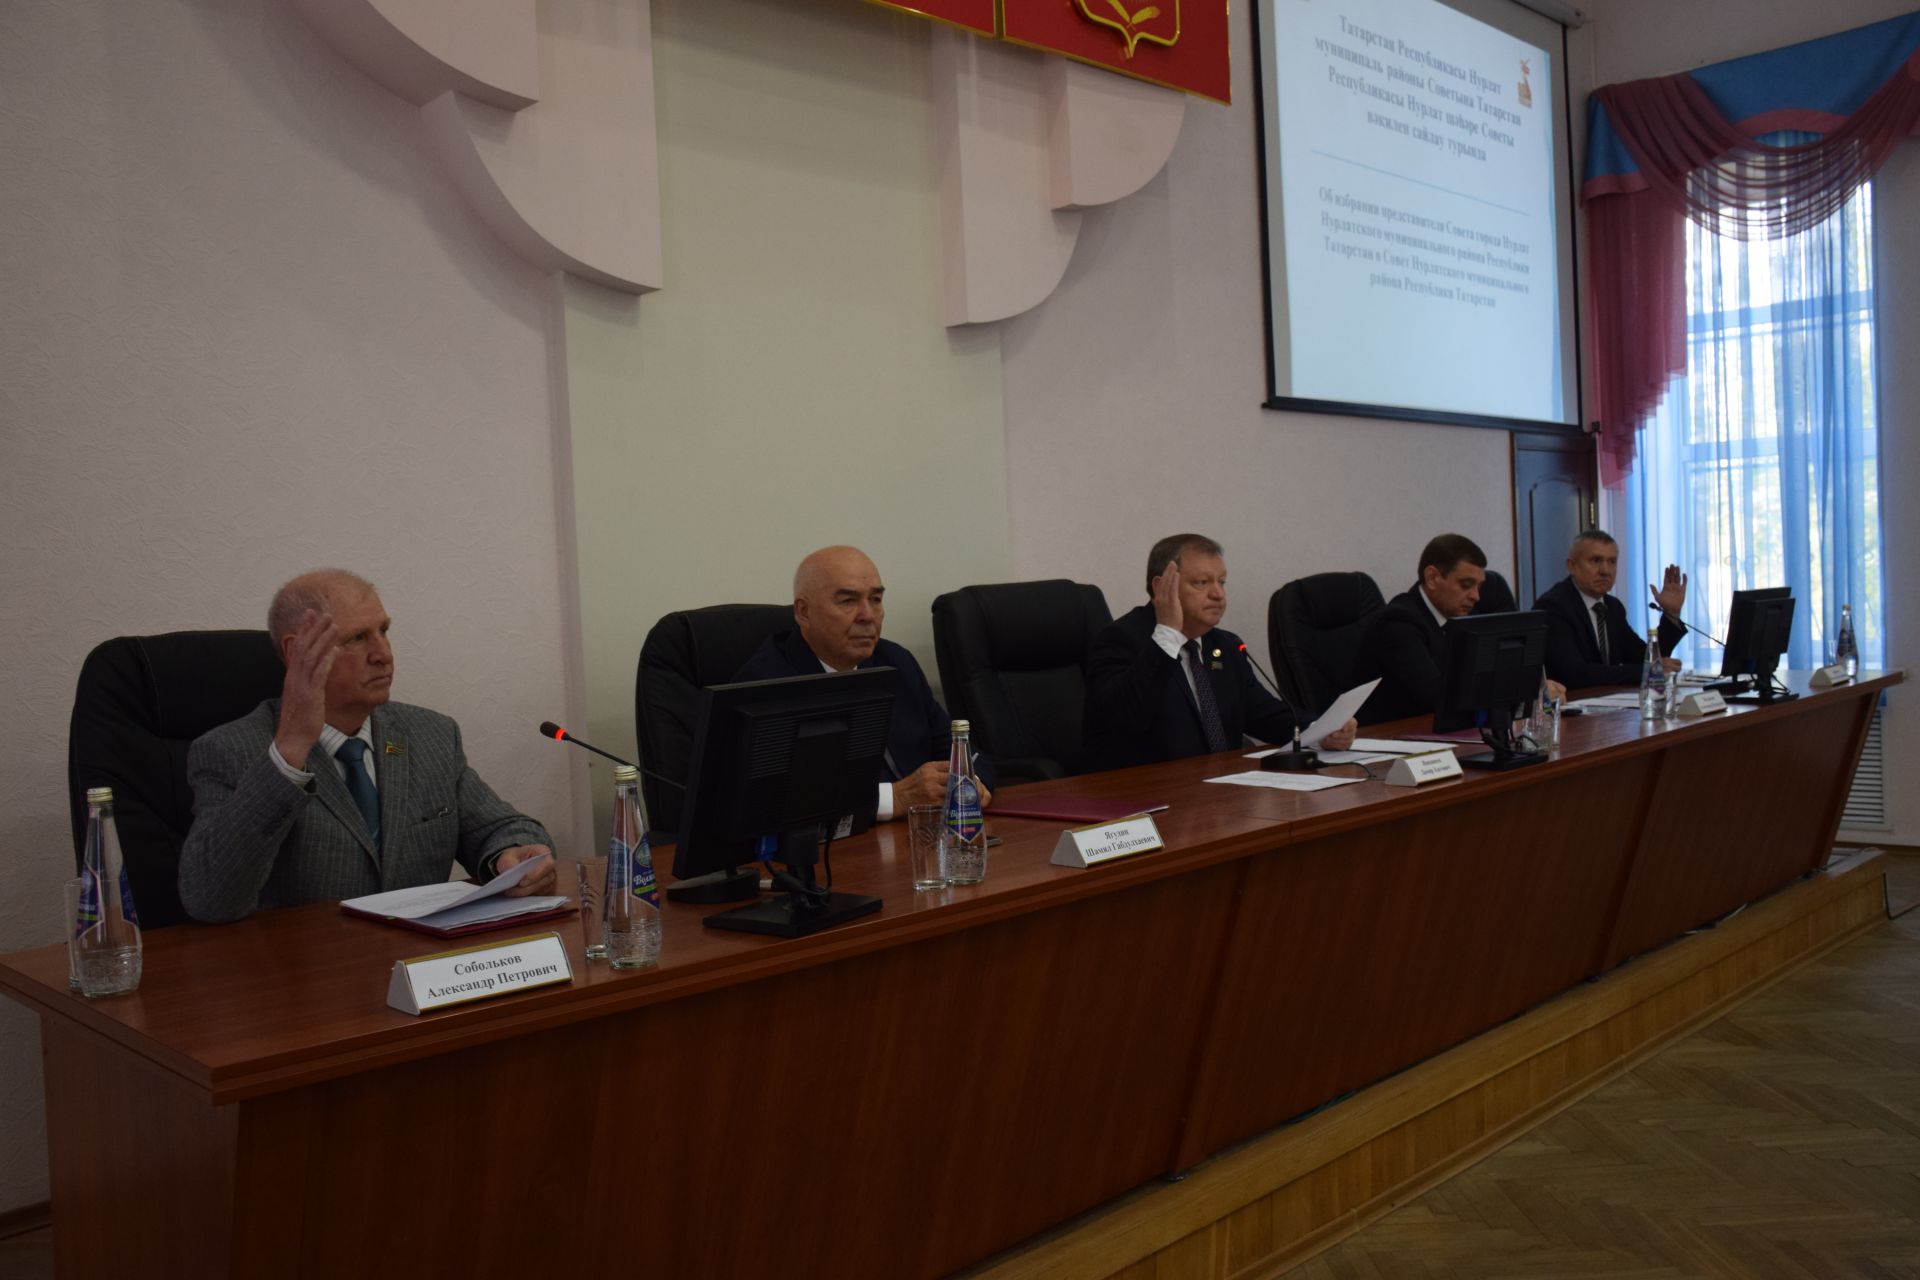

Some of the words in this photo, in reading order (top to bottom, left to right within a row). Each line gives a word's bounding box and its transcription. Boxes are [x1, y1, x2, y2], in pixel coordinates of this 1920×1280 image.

[1314, 37, 1384, 74] муниципаль
[1387, 64, 1424, 90] районы
[1427, 77, 1474, 108] Советына
[1476, 95, 1521, 127] Татарстан
[1338, 15, 1395, 51] Татарстан
[1398, 39, 1466, 80] Республикасы
[1469, 69, 1502, 95] Нурлат
[1328, 65, 1404, 107] Республикасы
[1407, 94, 1443, 121] Нурлат
[1481, 122, 1515, 147] Советы
[1412, 123, 1445, 149] сайлау
[1448, 140, 1487, 162] турында
[1319, 186, 1333, 203] Об
[1335, 194, 1380, 216] избрании
[1381, 205, 1445, 233] представителя
[1446, 220, 1475, 241] Совета
[1476, 231, 1501, 249] города
[1503, 235, 1530, 255] Нурлат
[1321, 210, 1382, 239] Нурлатского
[1384, 229, 1456, 257] муниципального
[1457, 247, 1485, 265] района
[1487, 252, 1530, 275] Республики
[1324, 236, 1374, 261] Татарстан
[1376, 250, 1382, 261] в
[1383, 250, 1410, 270] Совет
[1412, 257, 1465, 281] Нурлатского
[1466, 273, 1529, 295] муниципального
[1370, 272, 1402, 289] района
[1404, 276, 1454, 300] Республики
[1455, 287, 1496, 308] Татарстан
[427, 977, 495, 999] Александр
[498, 964, 558, 985] Петрович
[454, 954, 522, 976] Собольков
